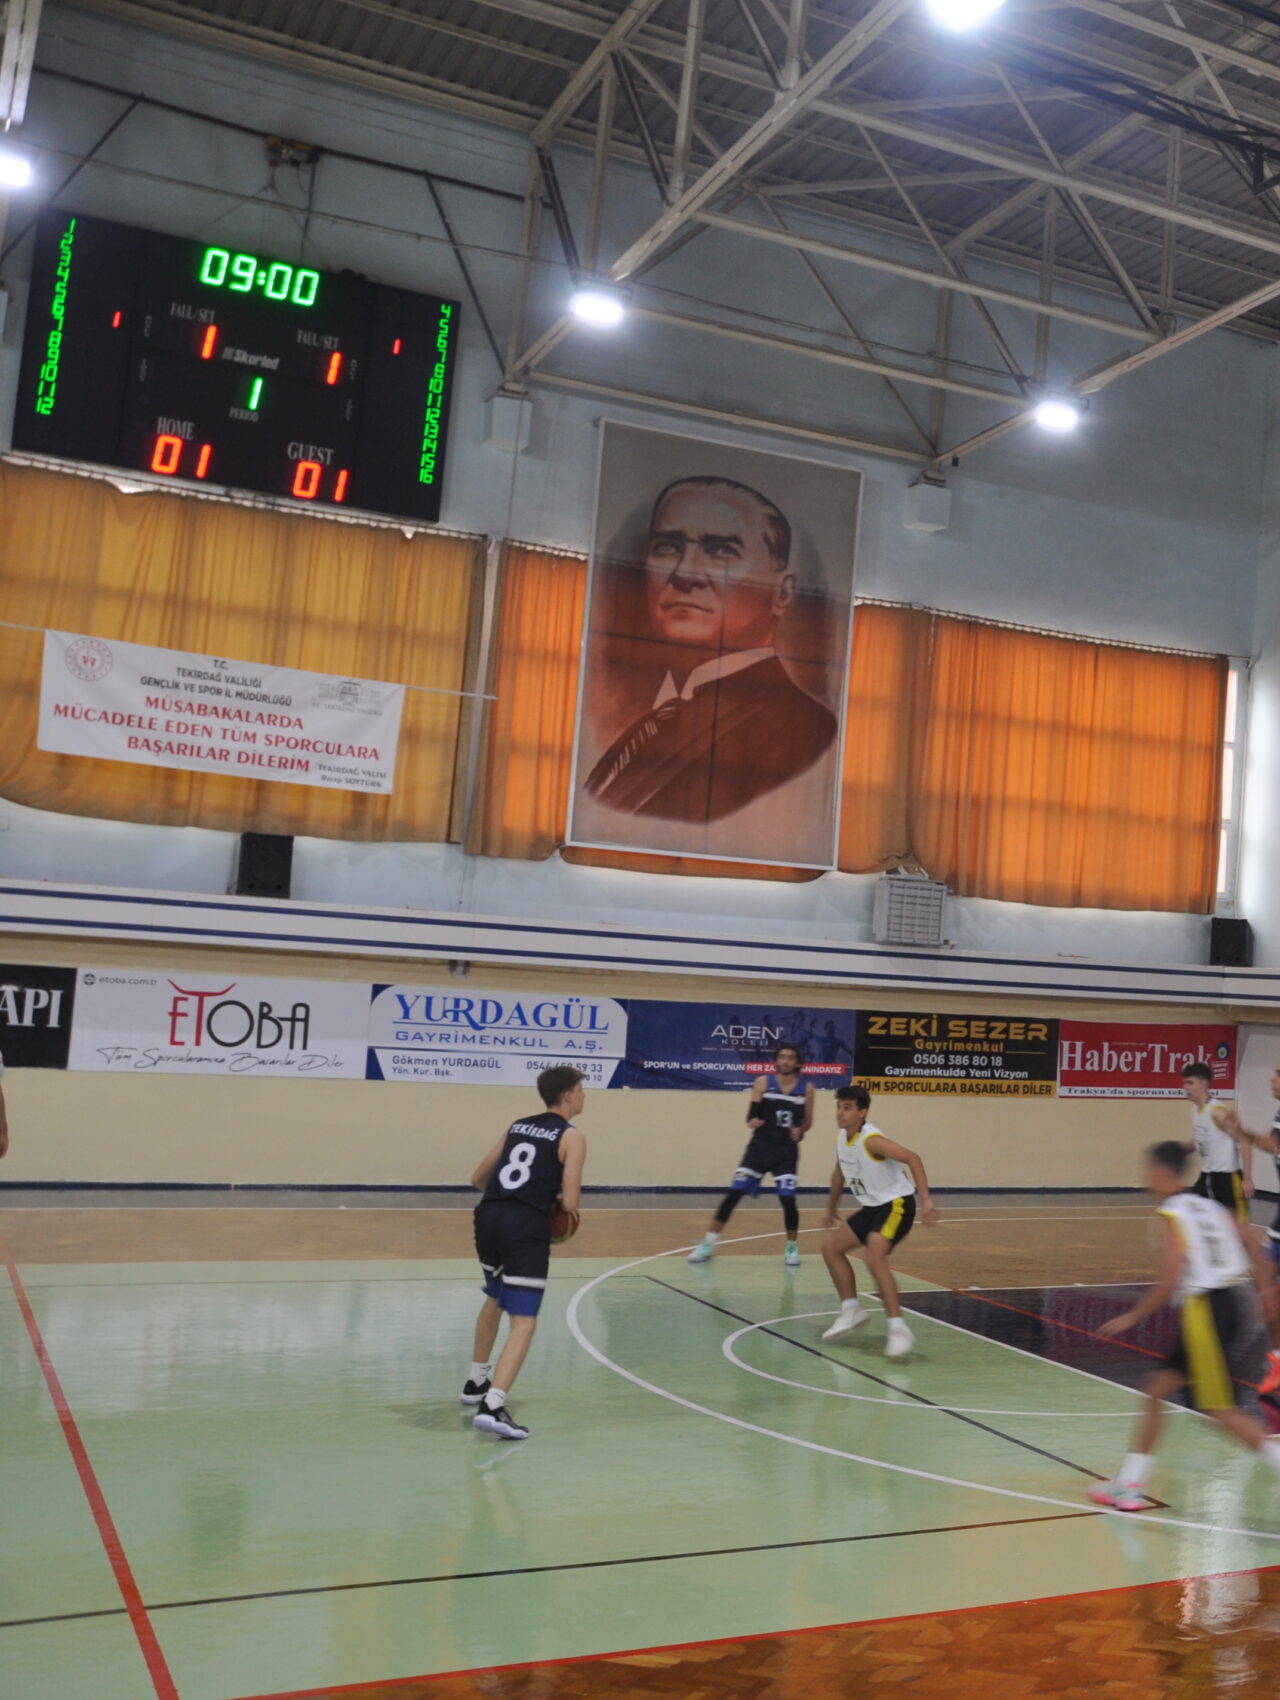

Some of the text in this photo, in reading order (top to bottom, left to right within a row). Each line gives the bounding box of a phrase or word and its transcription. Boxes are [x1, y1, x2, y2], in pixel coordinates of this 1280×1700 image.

[201, 247, 320, 306] 09:00
[201, 325, 217, 359] 1
[327, 351, 342, 385] 1
[248, 376, 263, 411] 1
[156, 416, 195, 440] HOME
[287, 441, 334, 466] GUEST
[176, 666, 223, 683] TEKİRDAĞ
[140, 675, 293, 706] GENÇLİK VE SPOR İL MÜDÜRLÜĞÜ
[145, 694, 305, 731] MÜSABAKALARDA
[53, 702, 380, 761] MÜCADELE EDEN TÜM SPORCULARA
[127, 736, 310, 773] BAŞARILAR DİLERİM
[99, 976, 157, 986] etoba.com.tr
[395, 993, 610, 1031] YURDAGÜL
[710, 1024, 780, 1040] ADEN
[868, 1014, 1048, 1041] ZEKİ SEZER
[395, 1030, 603, 1053] GAYRİMENKUL A.Ş.
[914, 1038, 1004, 1053] Gayrimenkul
[392, 1055, 438, 1067] Gökmen
[441, 1055, 502, 1069] YURDAGÜL
[591, 1063, 603, 1073] 33
[392, 1066, 411, 1076] Yön.
[413, 1067, 432, 1076] Kur.
[643, 1060, 680, 1069] SPOR'UN
[692, 1061, 745, 1071] SPORCU'NUN
[747, 1064, 763, 1072] HER
[913, 1053, 1003, 1067] 0506 386 80 18
[884, 1066, 1029, 1081] Gayrimenkulde Yeni Vizyon
[857, 1078, 1052, 1096] TÜM SPORCULARA BAŞARILAR DİLER
[1067, 1087, 1124, 1097] Trakya'da
[1127, 1088, 1165, 1097] sporun
[775, 1110, 793, 1128] 13
[510, 1122, 560, 1141] TEKİRDAĞ
[498, 1142, 537, 1190] 8
